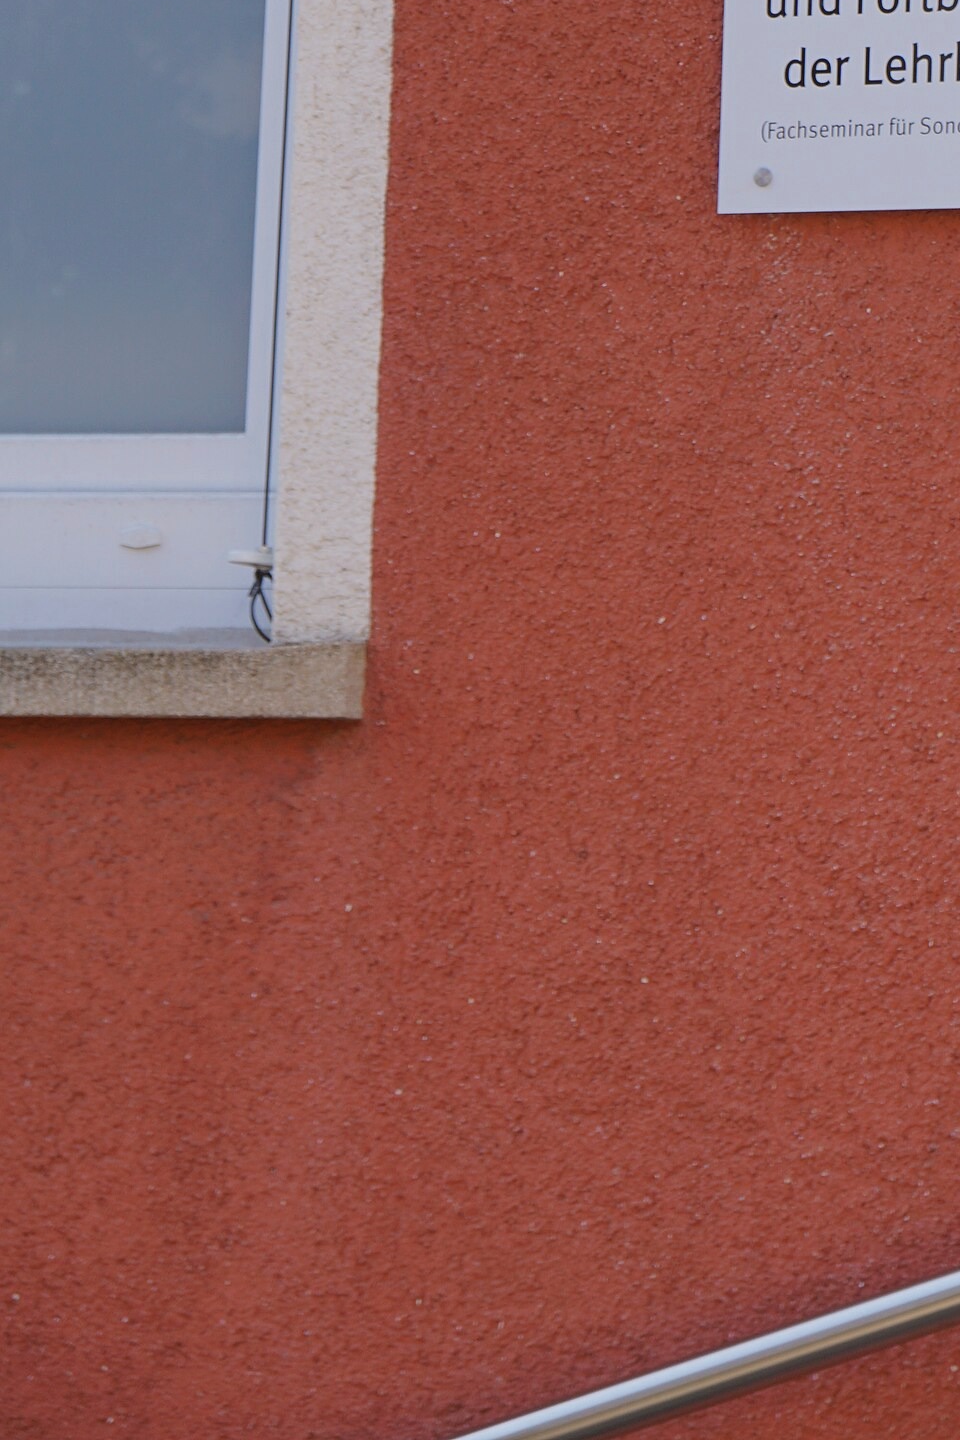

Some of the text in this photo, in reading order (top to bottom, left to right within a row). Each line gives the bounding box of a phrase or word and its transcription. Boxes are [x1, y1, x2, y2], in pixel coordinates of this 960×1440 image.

[784, 47, 850, 88] der
[761, 120, 884, 143] (Fachseminar
[890, 117, 915, 135] für
